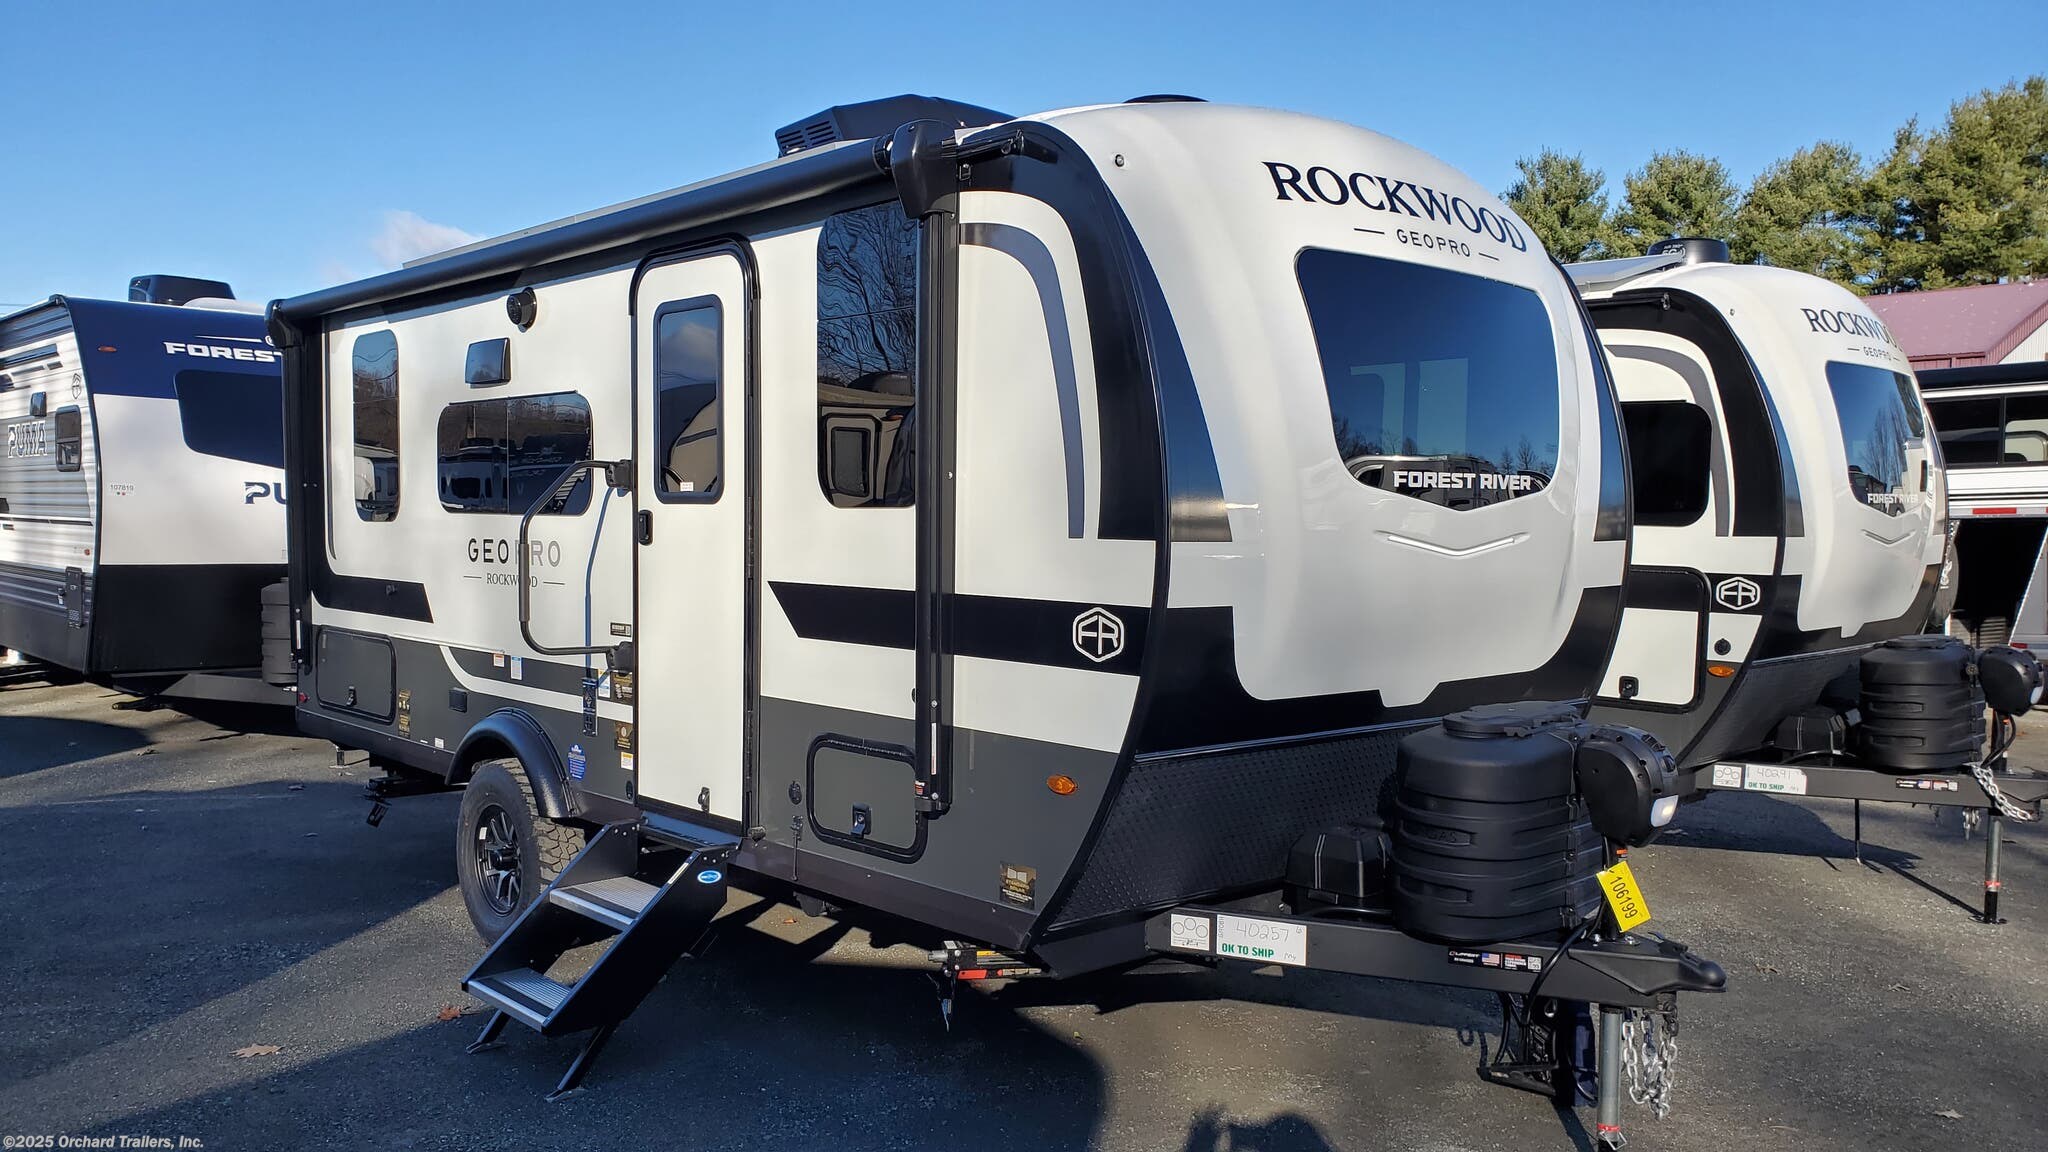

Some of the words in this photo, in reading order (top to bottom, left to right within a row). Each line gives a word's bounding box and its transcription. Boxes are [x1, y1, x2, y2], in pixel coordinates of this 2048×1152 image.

[1261, 160, 1528, 253] ROCKWOOD
[1395, 228, 1471, 258] GEOPRO
[1800, 307, 1903, 353] ROCKWOO
[7, 420, 48, 459] PUMA
[1393, 470, 1476, 489] FOREST
[1479, 473, 1532, 491] RIVER
[244, 481, 287, 505] PU
[1867, 493, 1898, 504] FOREST
[486, 572, 538, 588] ROCKWD
[1609, 876, 1638, 919] 106199
[1235, 921, 1289, 943] 40257
[1221, 942, 1234, 953] OK
[1237, 944, 1249, 955] TO
[1251, 946, 1275, 958] SHIP
